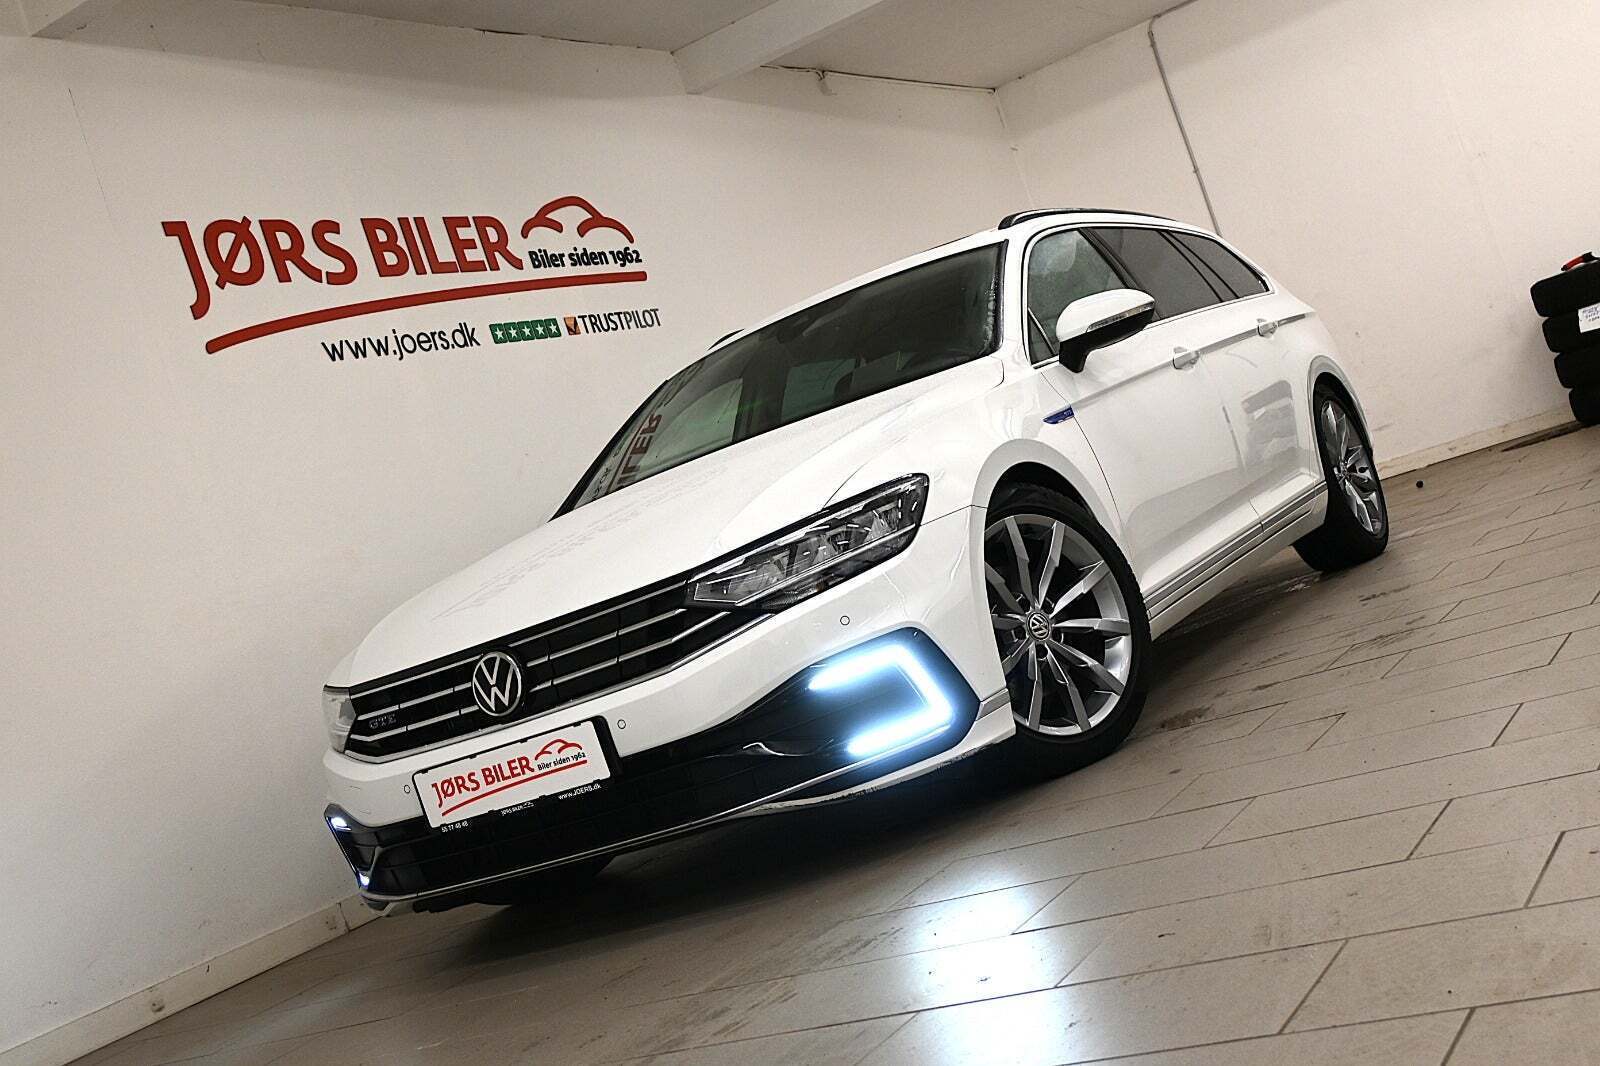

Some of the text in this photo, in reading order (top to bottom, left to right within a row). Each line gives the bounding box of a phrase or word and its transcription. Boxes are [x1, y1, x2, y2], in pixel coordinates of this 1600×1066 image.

[162, 215, 523, 320] JØRS BILER
[528, 246, 643, 269] Biler siden 1962
[578, 308, 662, 334] TRUSTPILOT
[321, 322, 481, 362] www.joers.dk
[537, 752, 586, 771] Biler siden 1962
[431, 756, 535, 808] JØRS BILER
